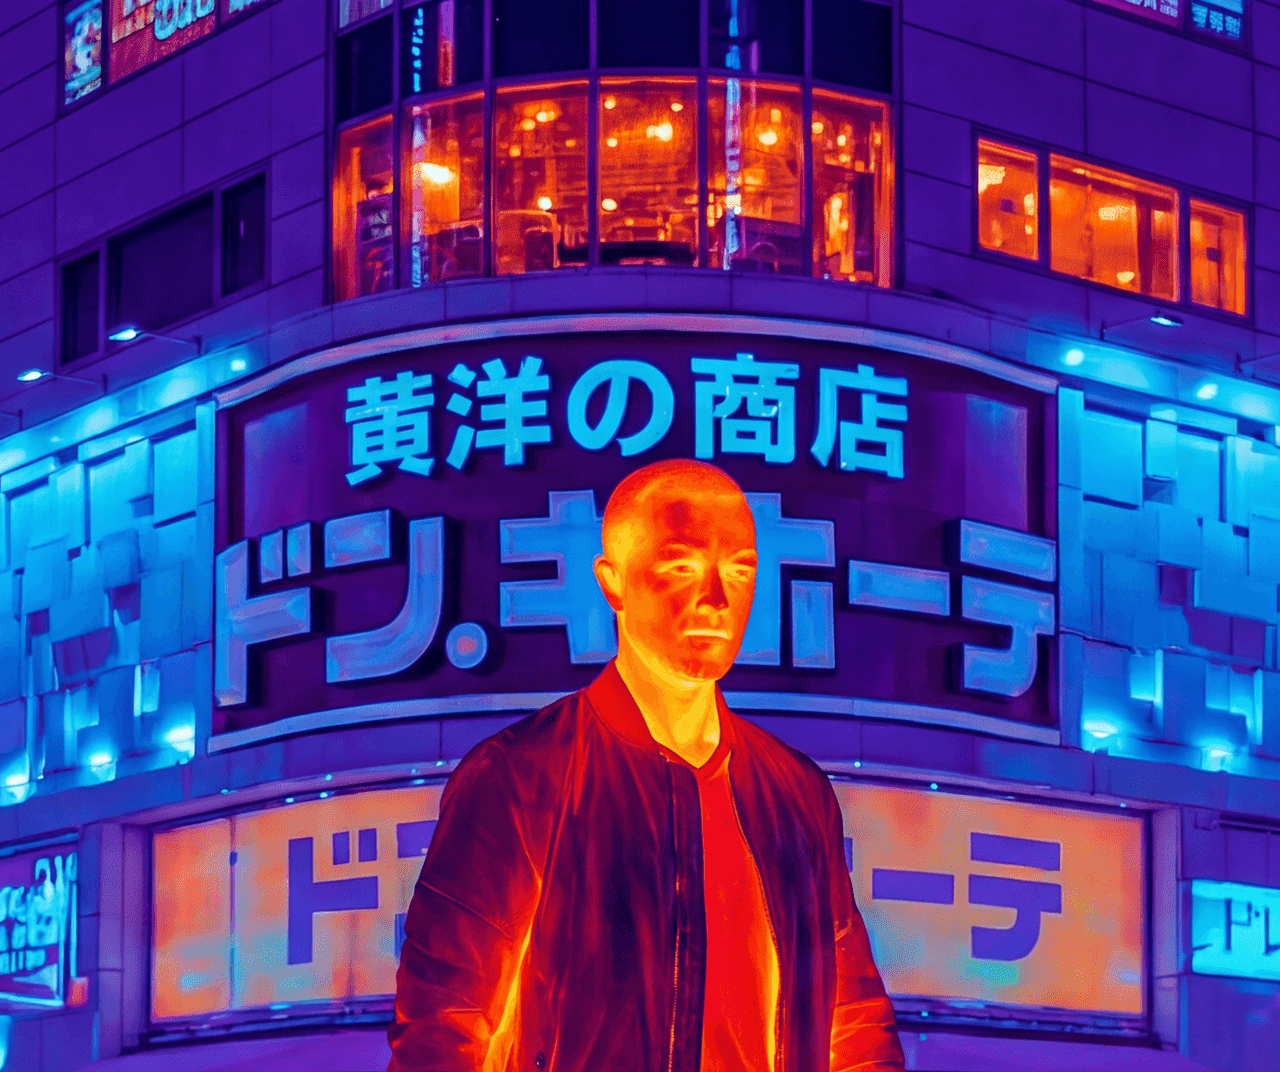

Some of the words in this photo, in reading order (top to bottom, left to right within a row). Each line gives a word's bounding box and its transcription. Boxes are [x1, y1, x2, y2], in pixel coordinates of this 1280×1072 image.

[345, 353, 909, 486] 黄洋の商店
